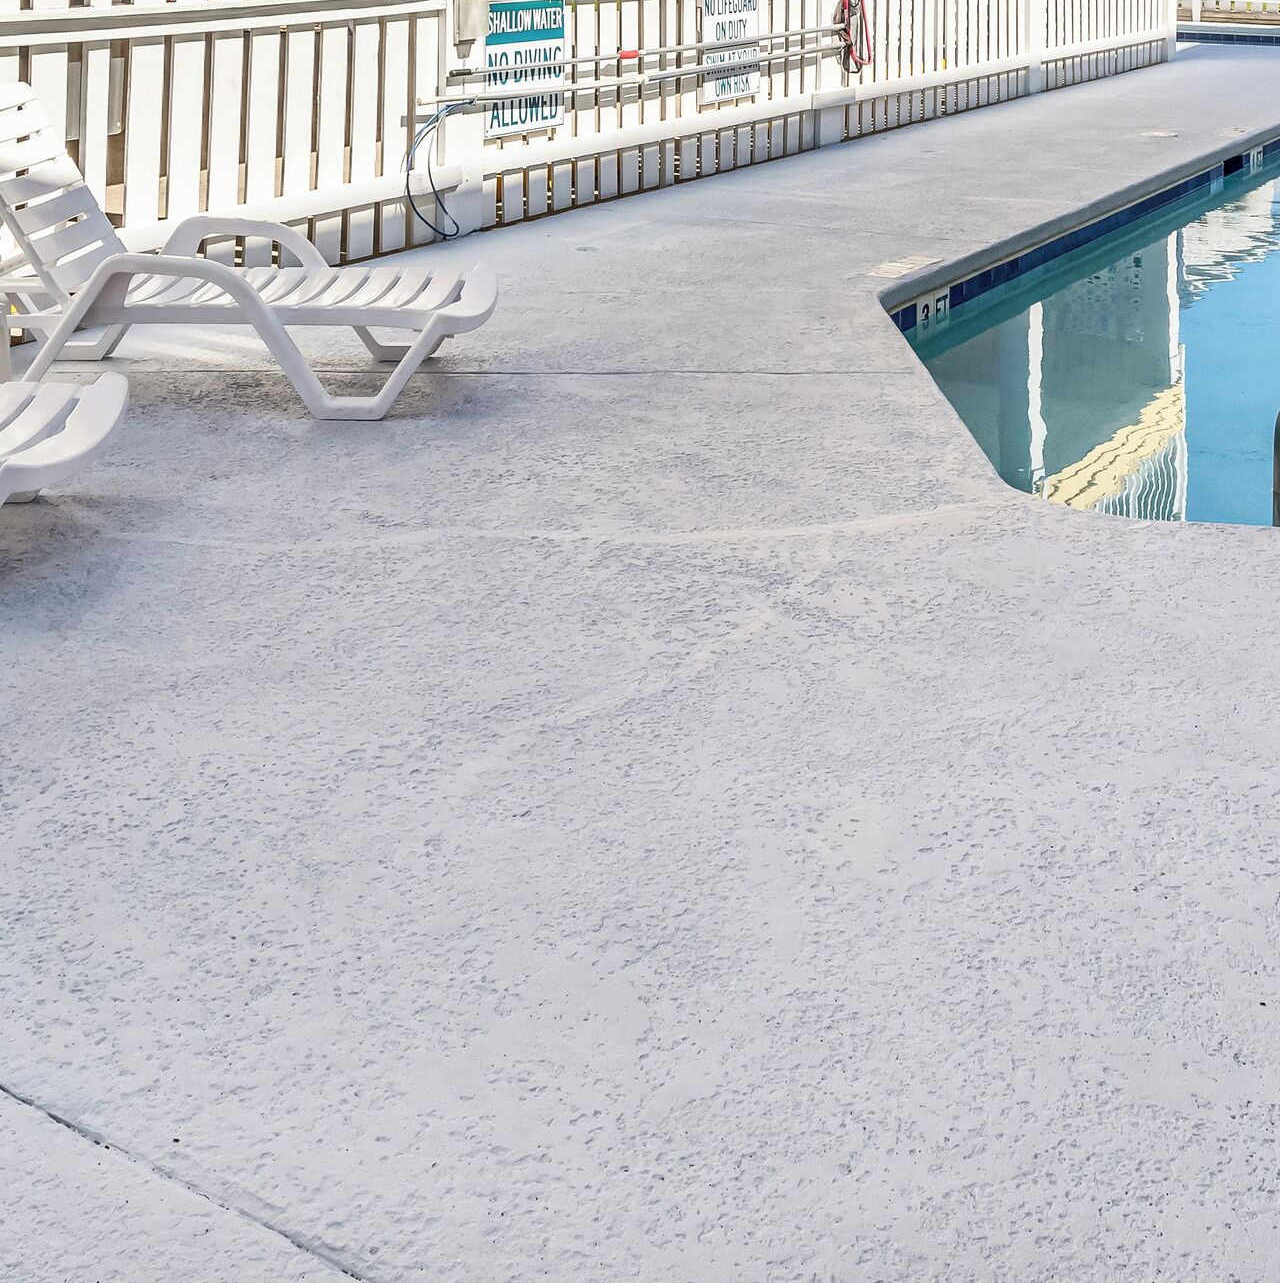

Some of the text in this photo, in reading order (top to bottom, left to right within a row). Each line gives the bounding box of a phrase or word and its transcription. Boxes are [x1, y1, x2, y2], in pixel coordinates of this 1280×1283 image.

[486, 7, 563, 36] SHALLOW WATER
[715, 19, 747, 41] ON DUTY
[488, 46, 562, 86] NO DIVING
[714, 73, 750, 97] OWN RISK
[490, 93, 559, 129] ALLOWED
